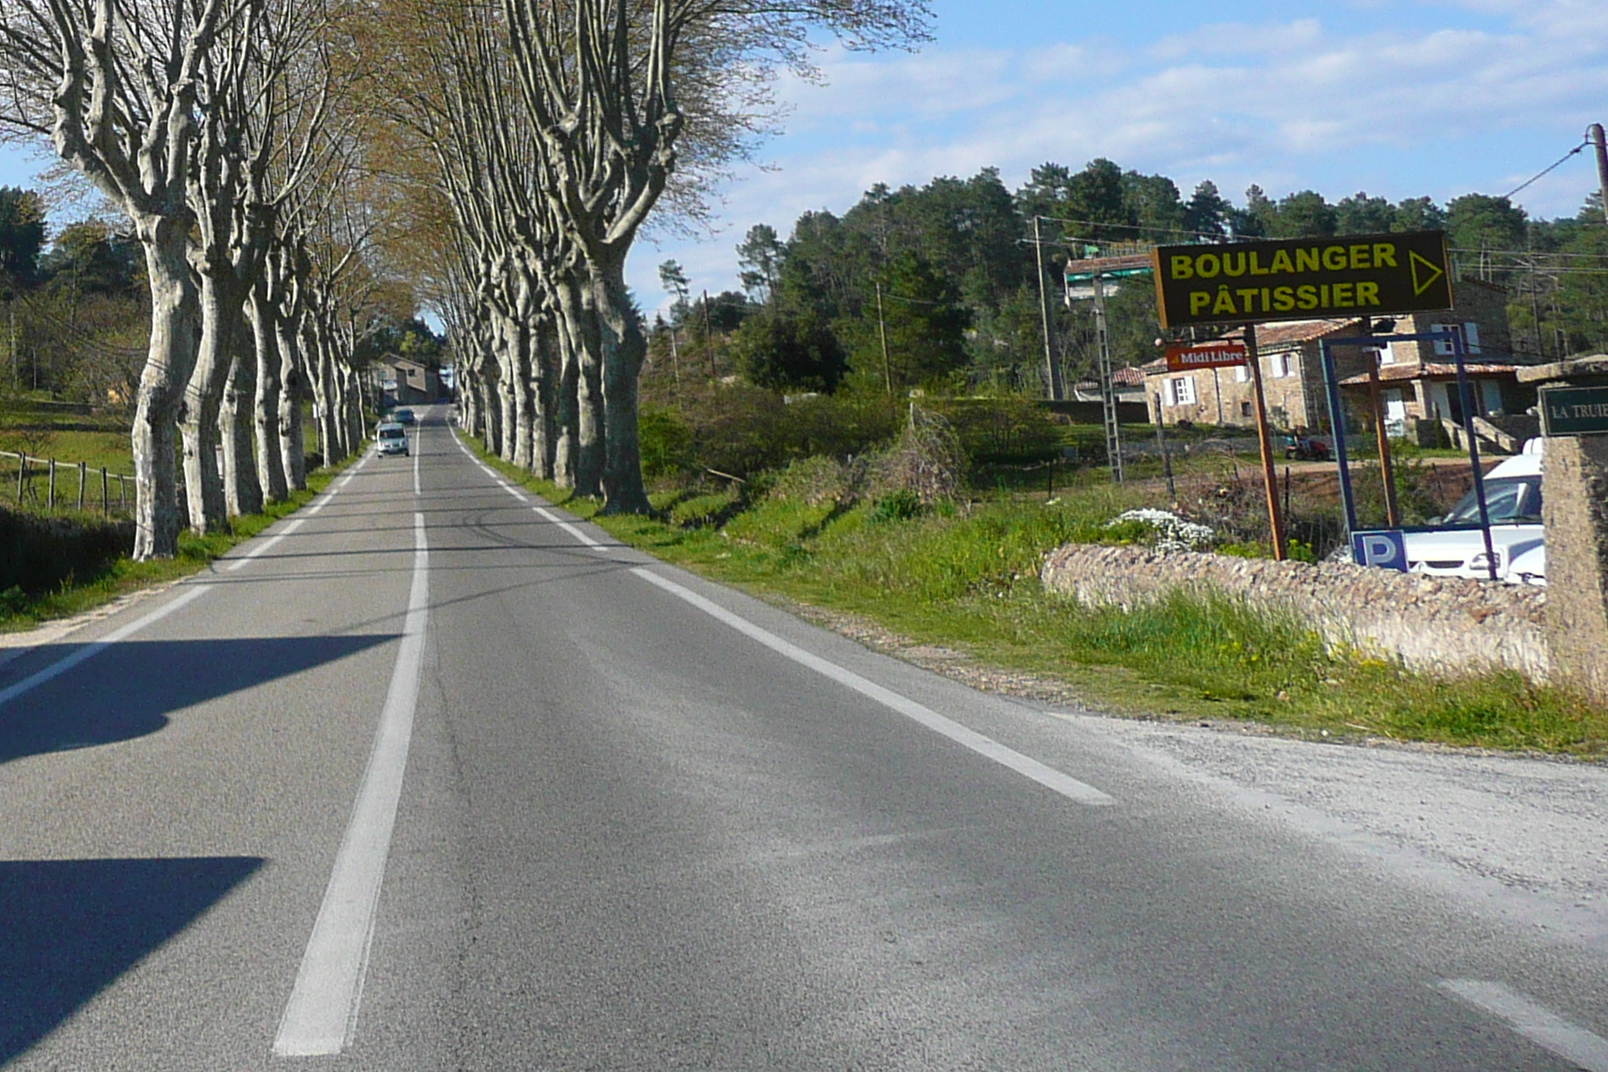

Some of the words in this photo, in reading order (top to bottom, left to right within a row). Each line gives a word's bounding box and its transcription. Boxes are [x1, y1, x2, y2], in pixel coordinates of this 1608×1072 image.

[1170, 243, 1398, 280] BOULANGER
[1189, 281, 1381, 316] PÂTISSIER
[1180, 351, 1209, 364] Midi
[1211, 349, 1243, 363] Libre
[1551, 405, 1569, 419] LA
[1362, 535, 1396, 568] P
